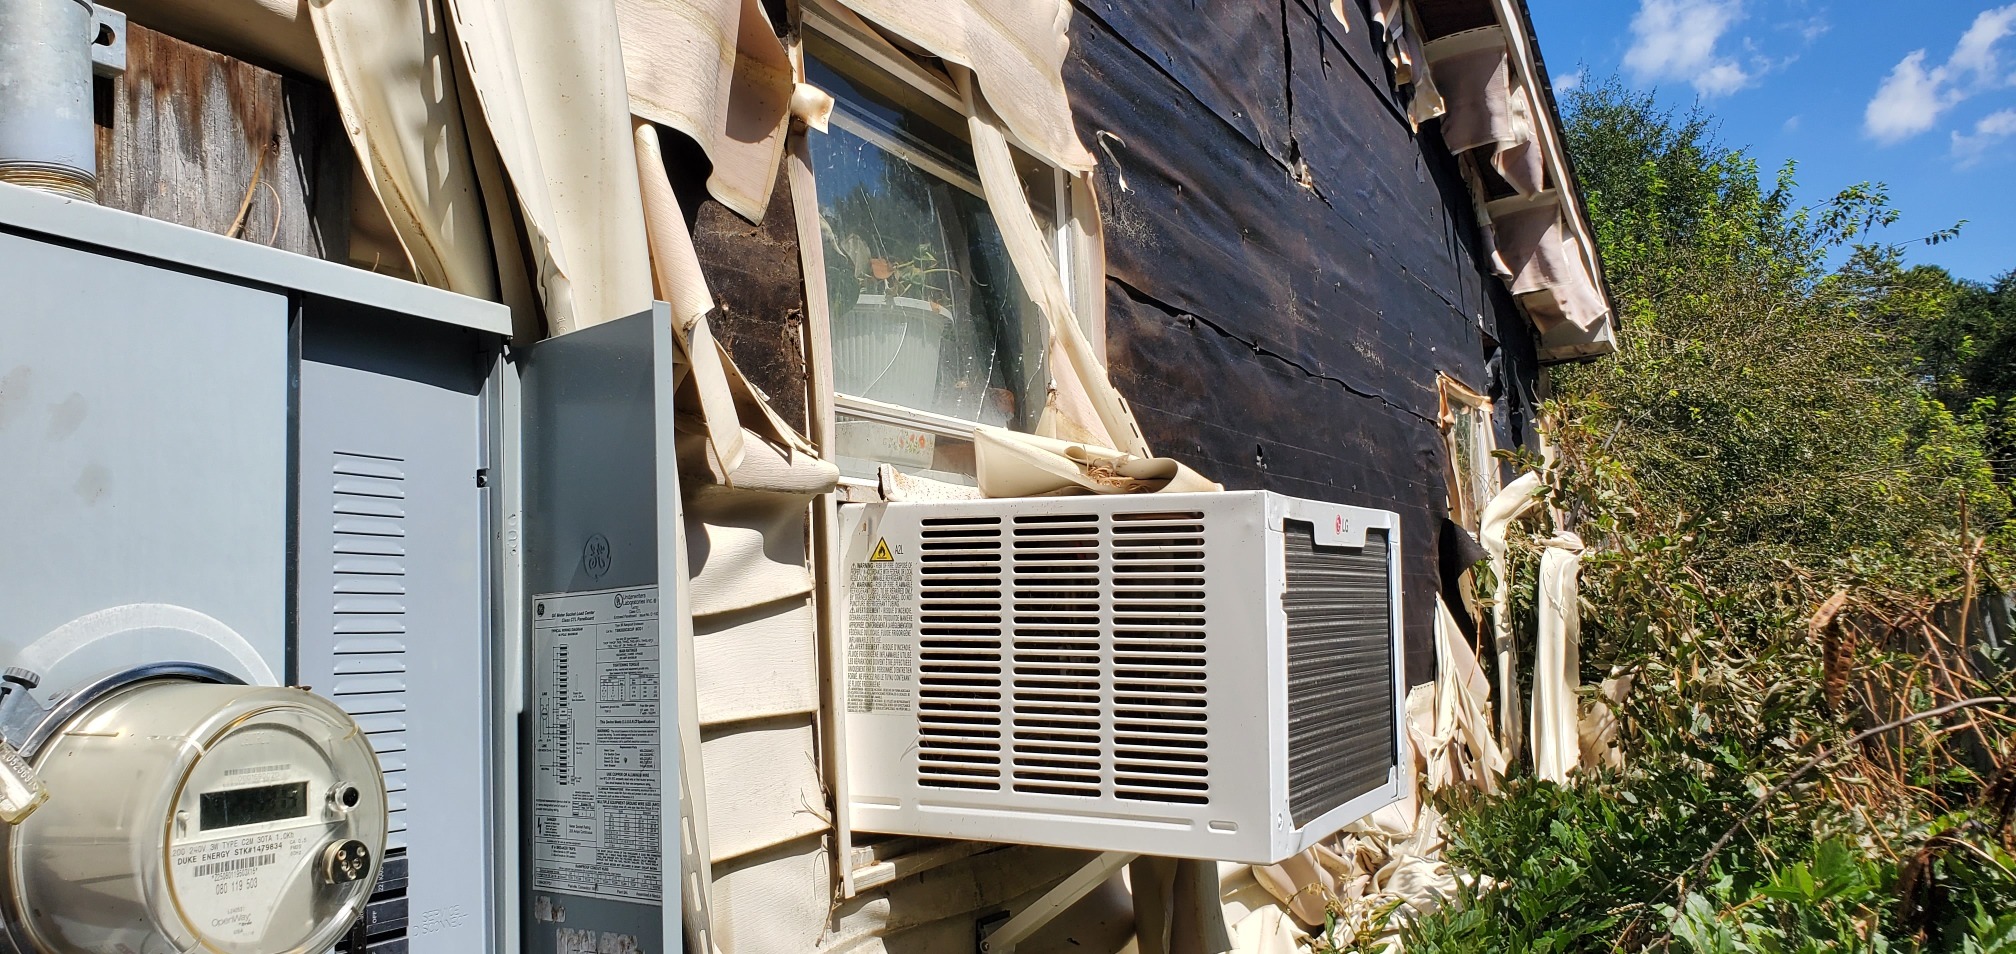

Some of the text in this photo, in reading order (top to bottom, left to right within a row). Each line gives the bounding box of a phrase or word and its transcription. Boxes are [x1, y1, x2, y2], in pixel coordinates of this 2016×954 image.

[1342, 519, 1349, 532] LG
[894, 544, 904, 554] A2L
[178, 855, 197, 865] DUKE
[202, 850, 230, 861] ENERGY
[216, 878, 258, 895] 080 119 503
[212, 913, 251, 927] OpenWay
